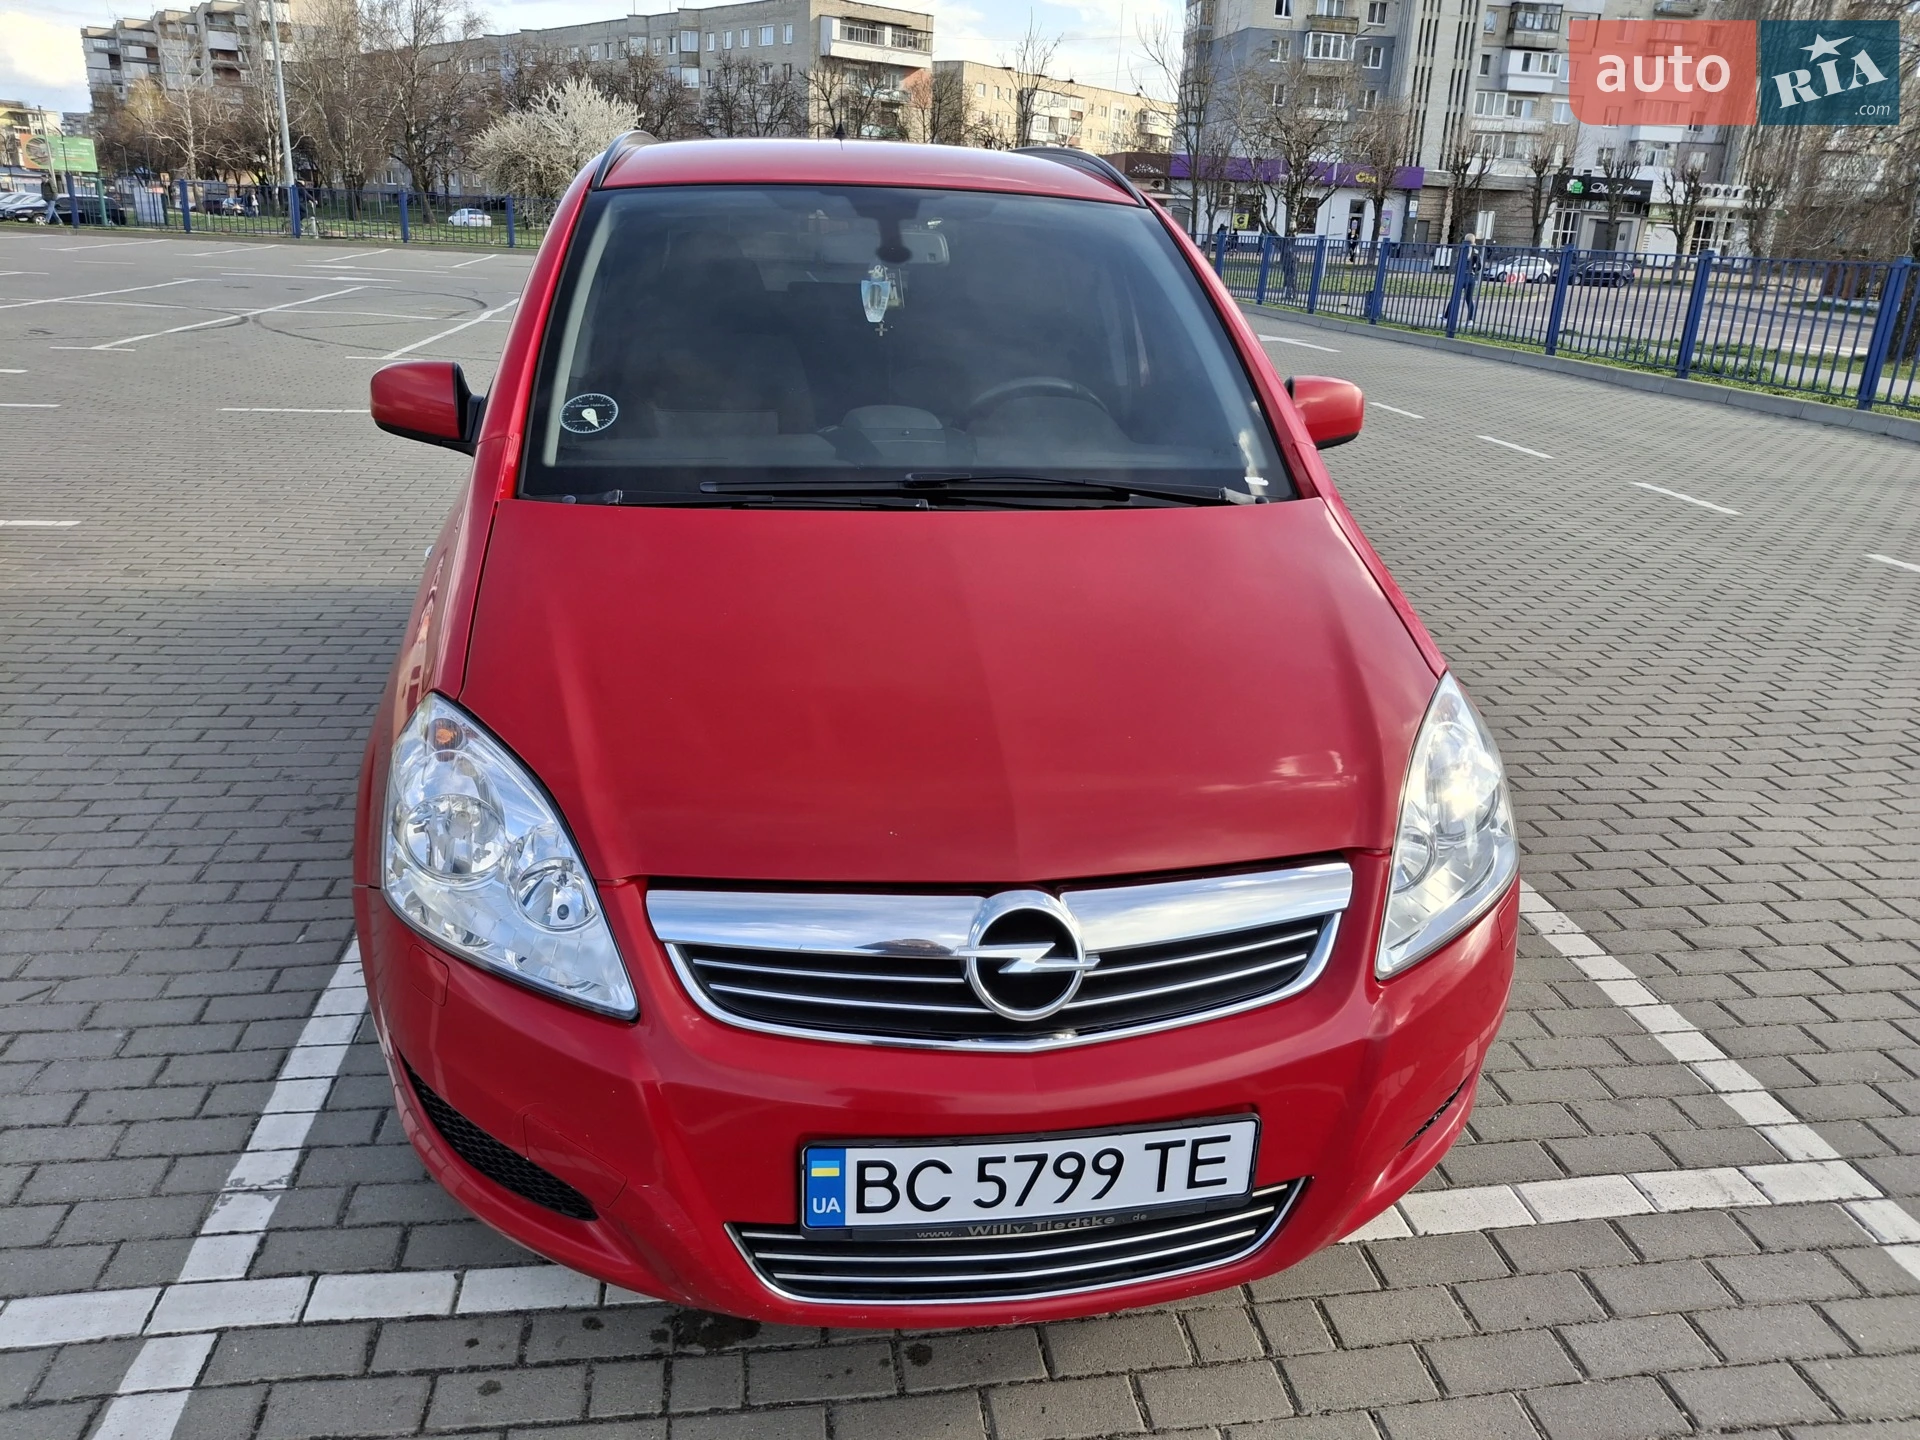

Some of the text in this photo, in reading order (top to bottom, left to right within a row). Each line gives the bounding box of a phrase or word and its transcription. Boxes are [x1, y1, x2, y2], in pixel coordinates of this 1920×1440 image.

[856, 1135, 1231, 1214] BC 5799 TE
[812, 1197, 841, 1214] UA
[1032, 1216, 1115, 1232] Tiedtke
